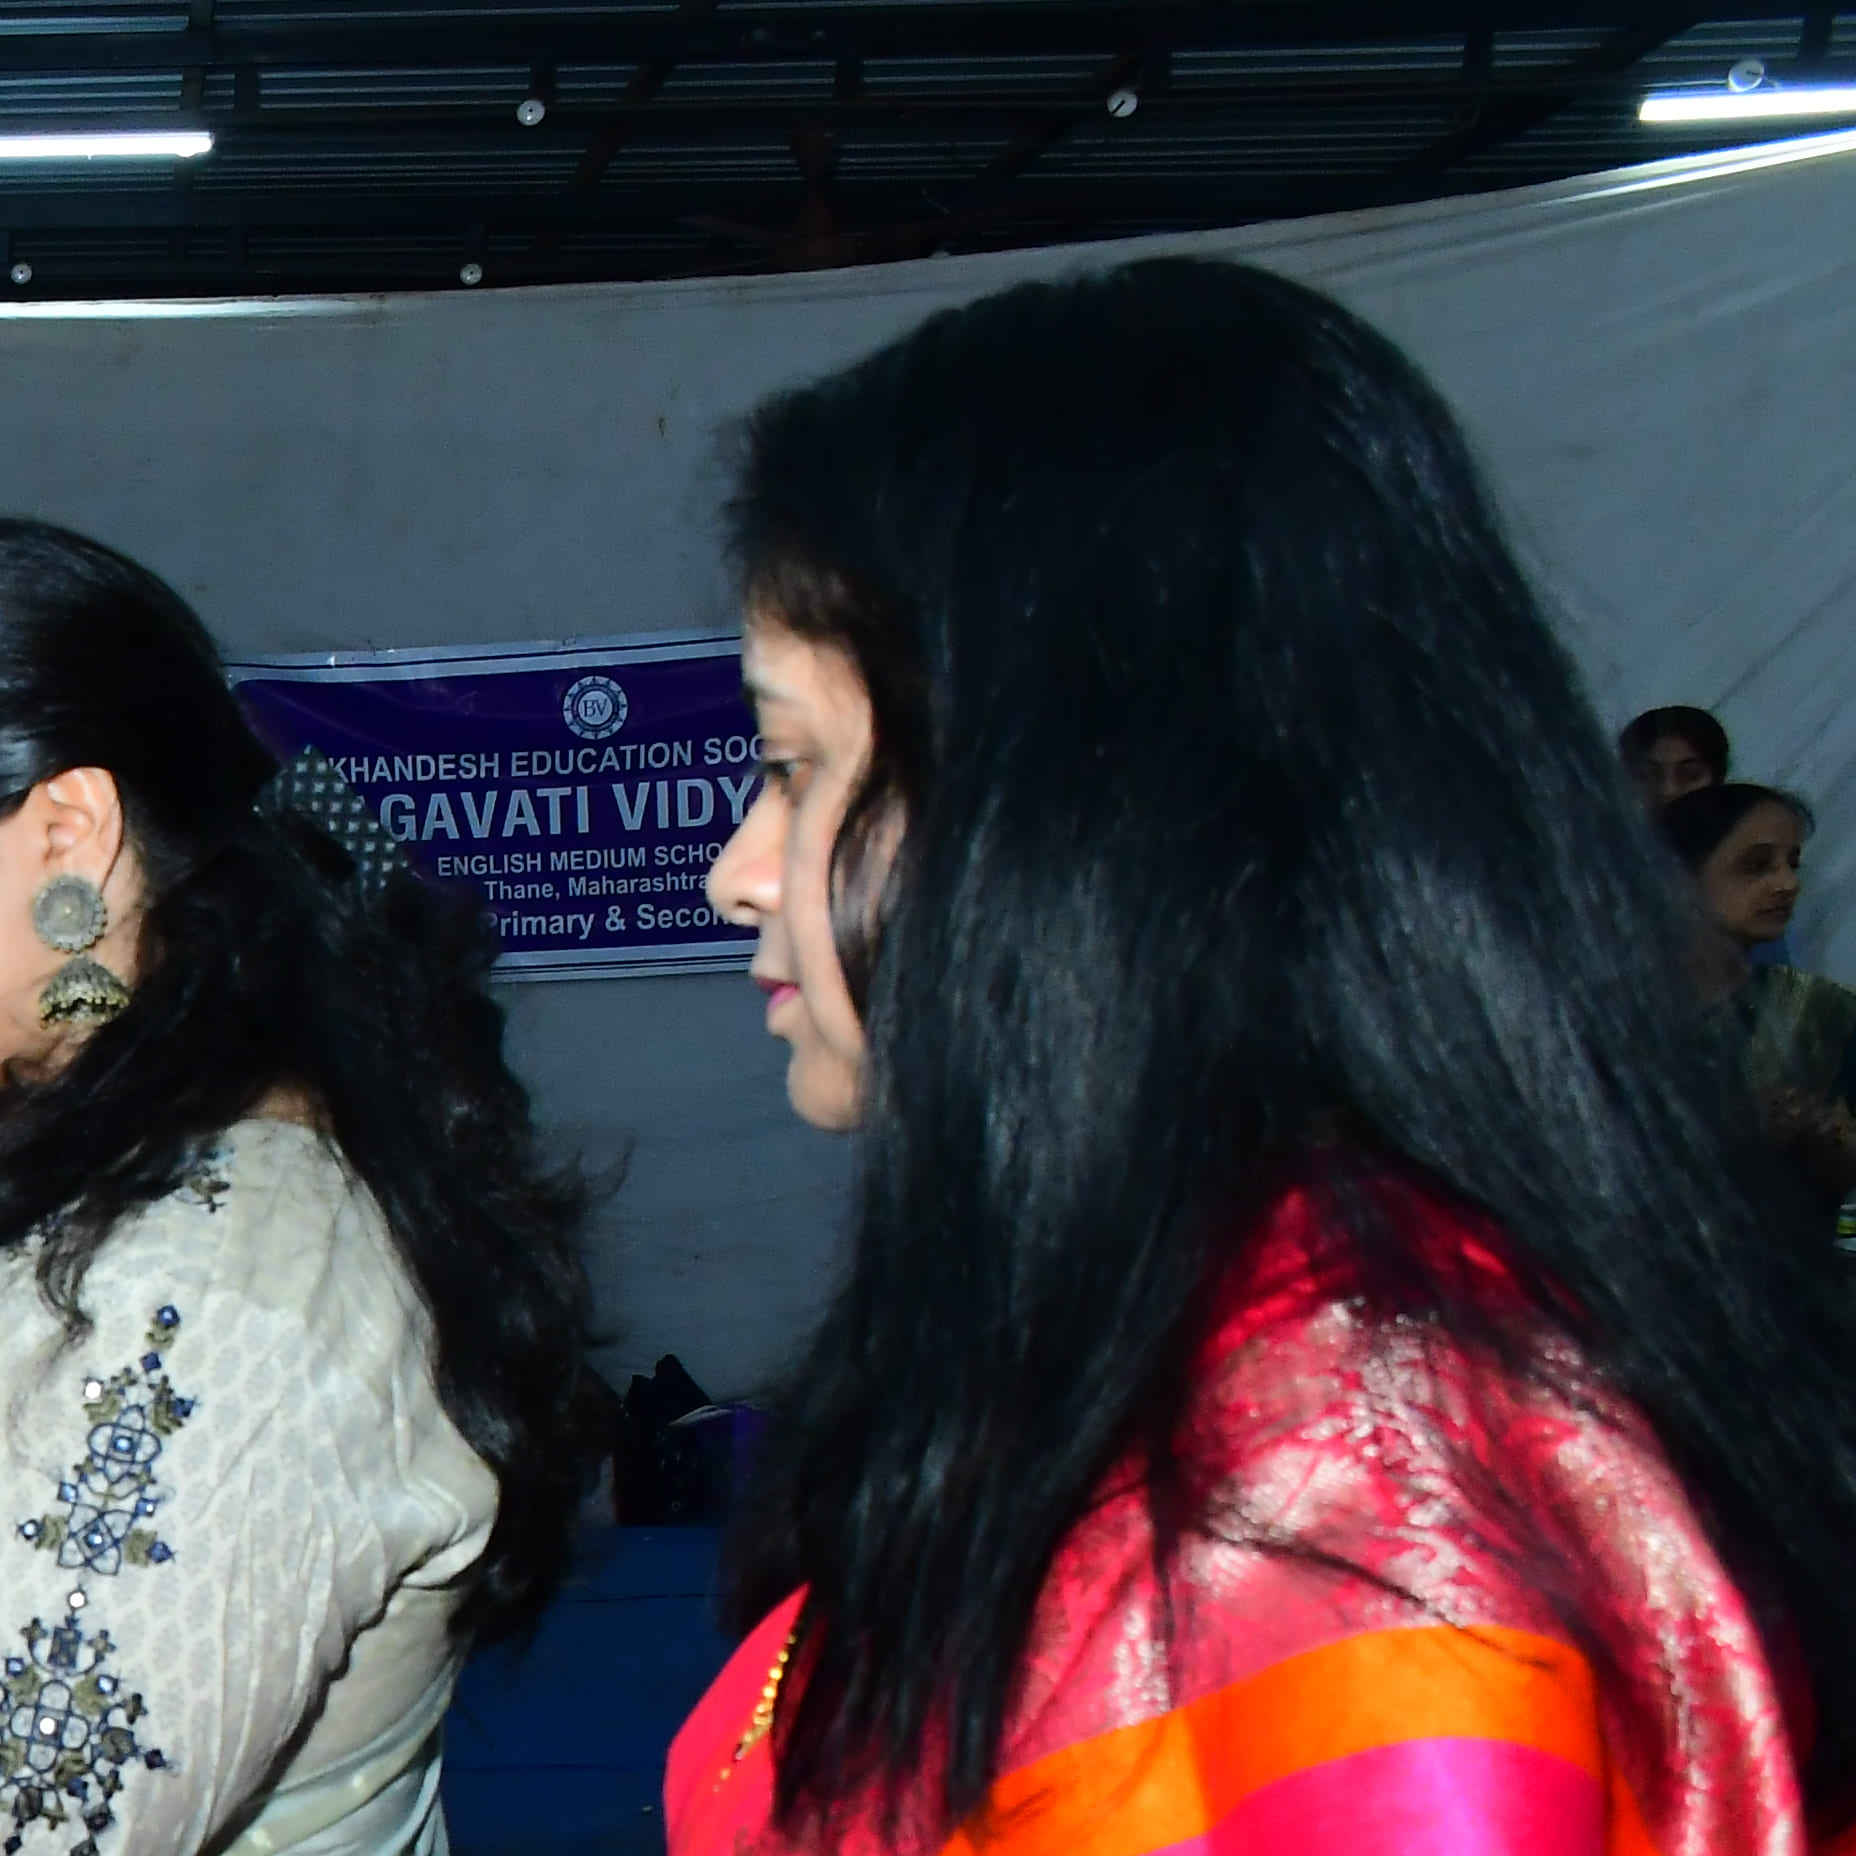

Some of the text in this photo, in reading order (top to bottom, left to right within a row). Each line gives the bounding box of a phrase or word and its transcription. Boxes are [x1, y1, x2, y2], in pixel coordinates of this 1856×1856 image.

[328, 752, 499, 783] KHANDESH
[511, 740, 692, 777] EDUCATION
[358, 786, 590, 842] GAVATI
[438, 852, 542, 877] ENGLISH
[550, 847, 646, 871] MEDIUM
[484, 871, 708, 901] Thane, Maharashtra
[605, 905, 626, 932] &
